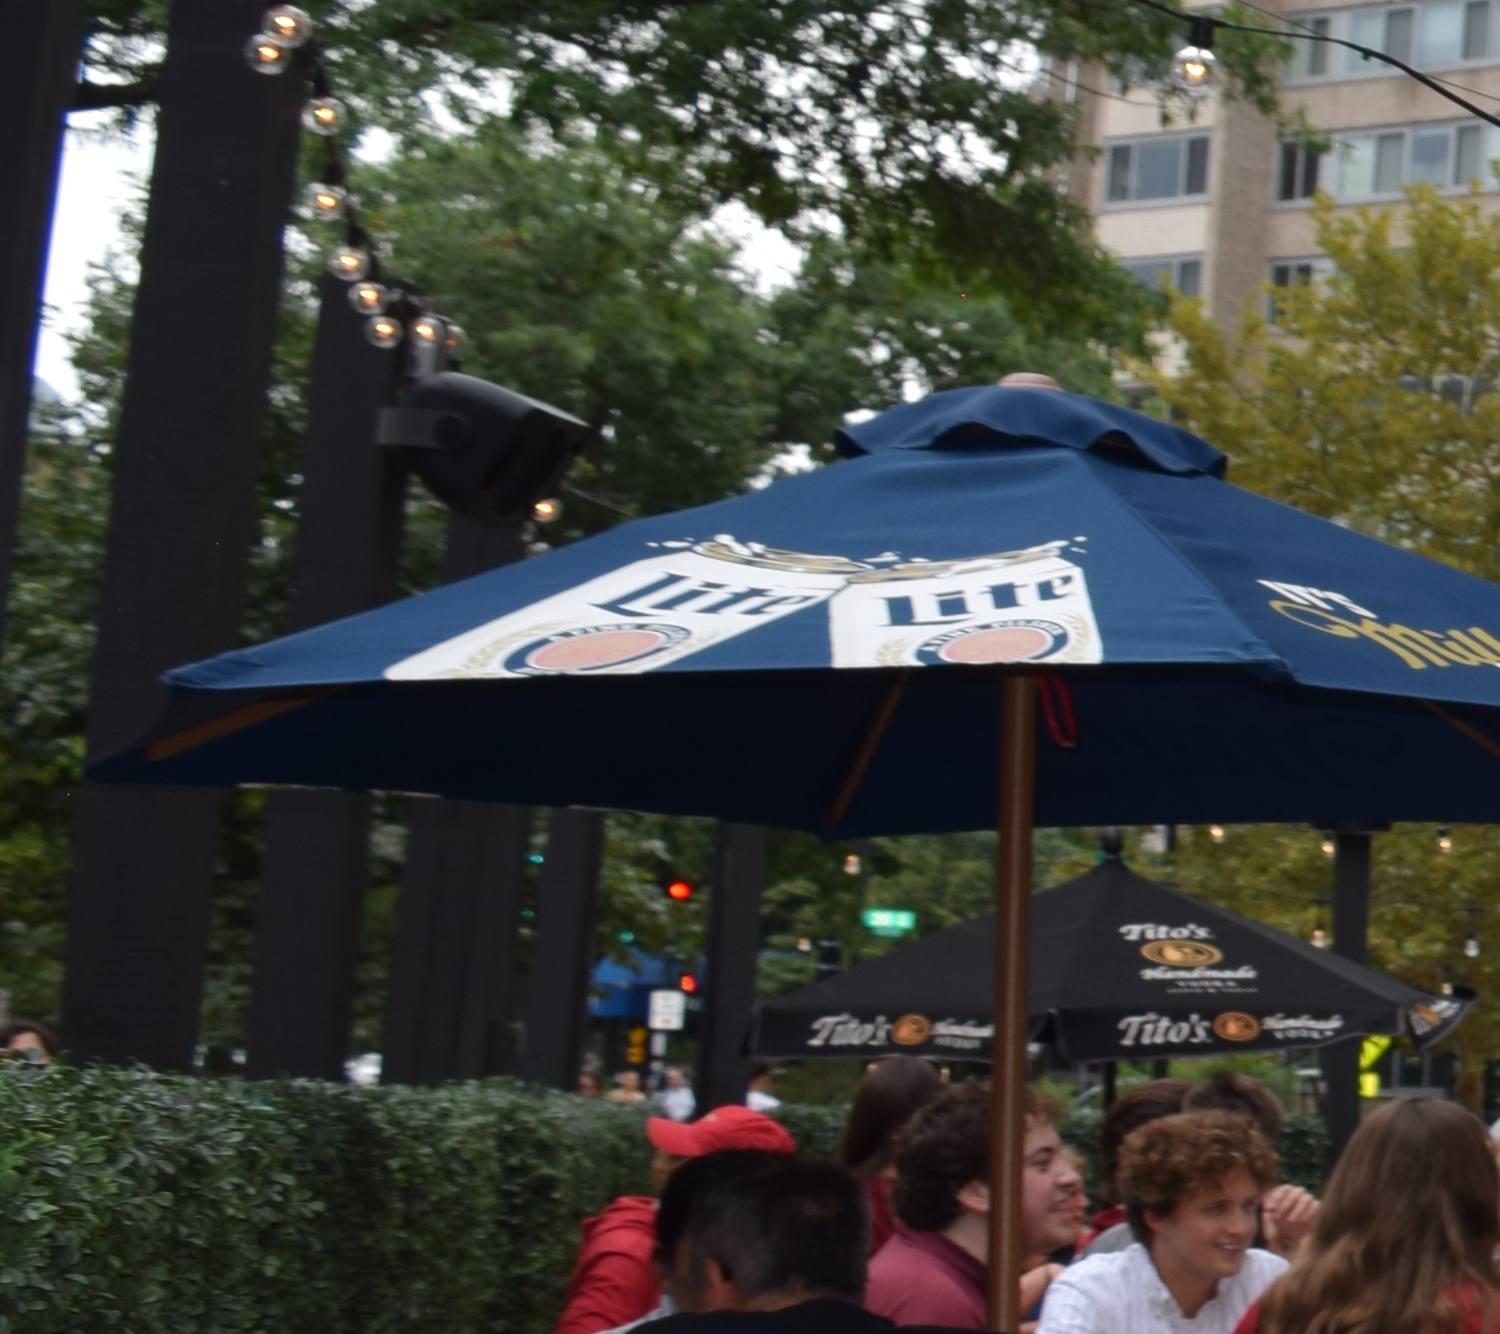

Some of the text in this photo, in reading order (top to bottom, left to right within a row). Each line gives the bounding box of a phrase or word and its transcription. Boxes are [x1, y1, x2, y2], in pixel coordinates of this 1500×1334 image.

[588, 570, 819, 618] Lite
[878, 573, 1075, 627] Lite
[1256, 579, 1377, 619] IT'S
[1118, 923, 1216, 941] Tito's
[1118, 1013, 1212, 1047] Tito's
